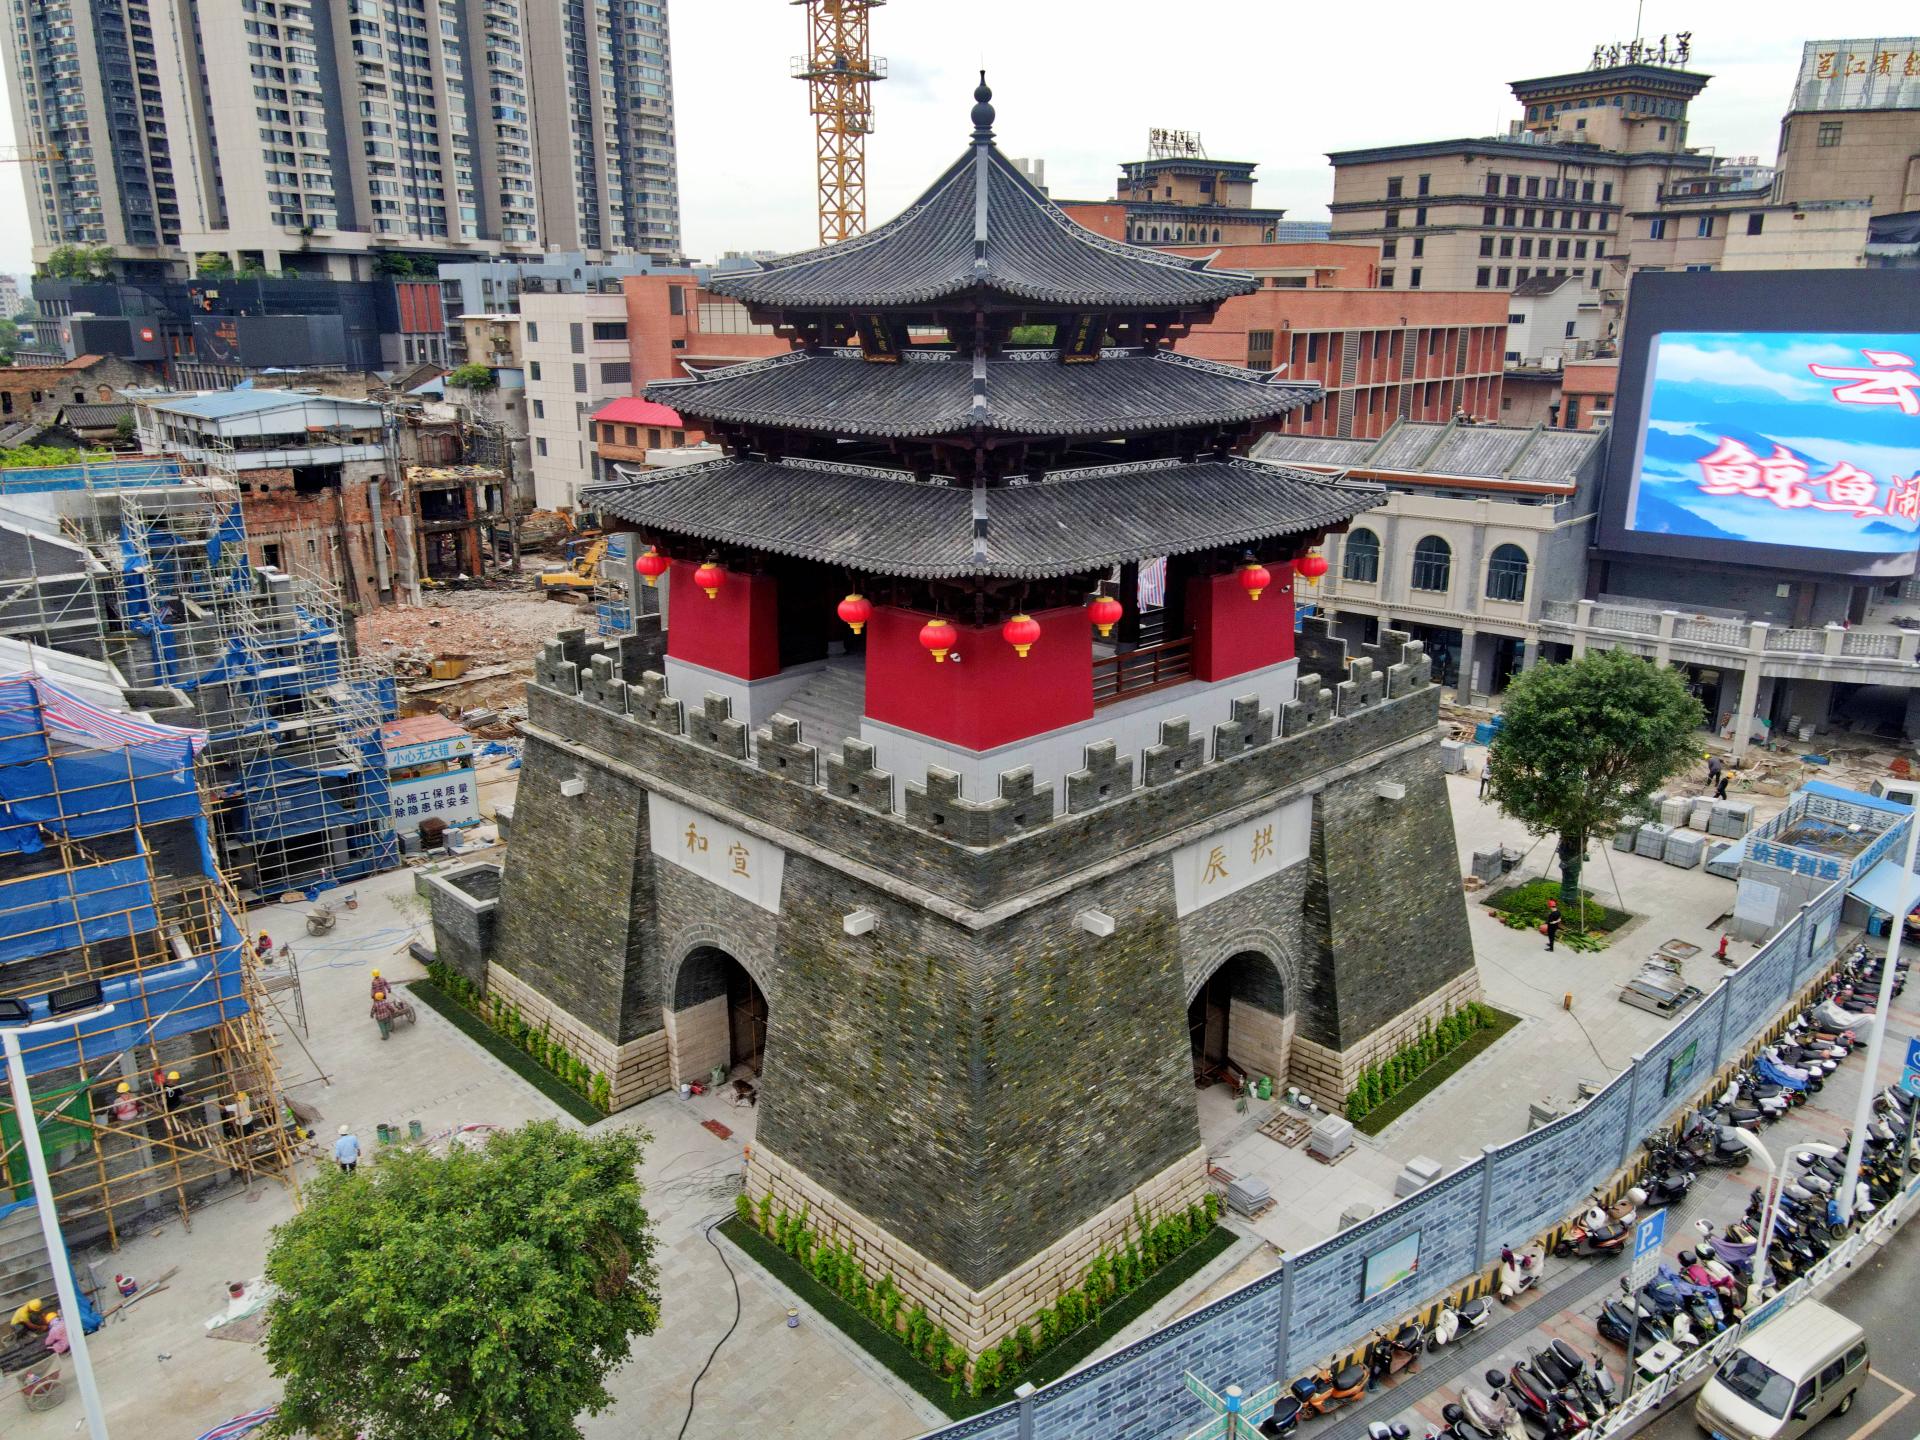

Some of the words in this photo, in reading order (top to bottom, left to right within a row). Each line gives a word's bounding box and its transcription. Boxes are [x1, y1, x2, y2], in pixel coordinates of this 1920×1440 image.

[1808, 349, 1920, 415] 云
[394, 743, 449, 766] 小心无大错
[1638, 1221, 1654, 1253] P
